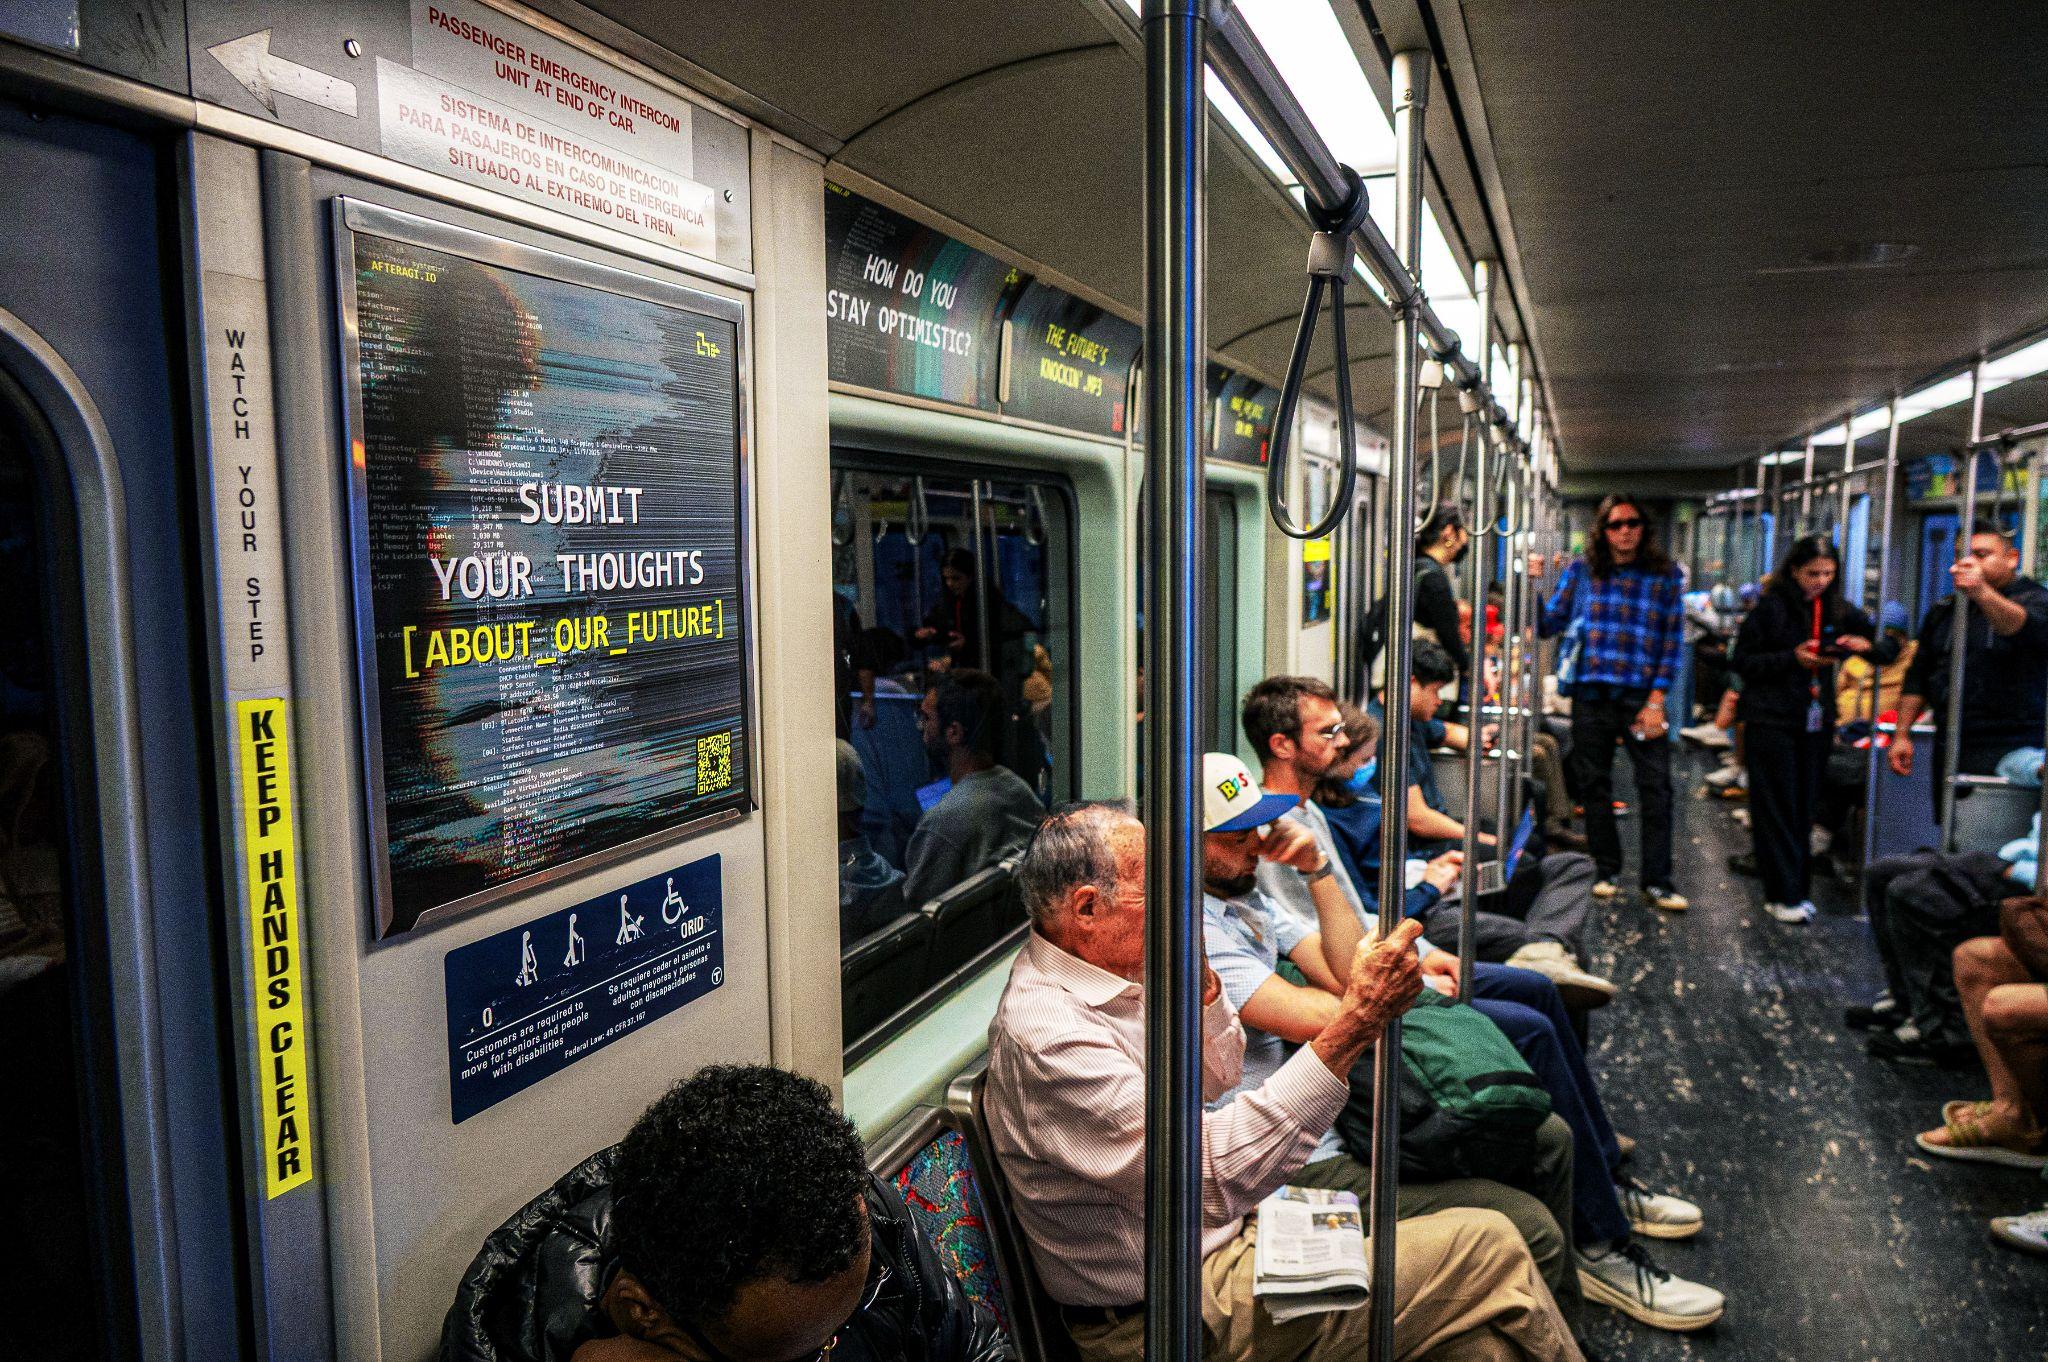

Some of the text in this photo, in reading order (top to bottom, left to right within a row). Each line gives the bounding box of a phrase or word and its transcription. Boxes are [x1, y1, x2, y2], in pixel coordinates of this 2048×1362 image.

[429, 6, 680, 133] PASSENGER EMERGENCY INTERCOM
[495, 60, 636, 135] UNIT AT END OF CAR.
[399, 104, 705, 228] PARA PASAJEROS EN CASO DE EMERGENCIA
[440, 94, 679, 198] SISTEMA DE INTERCOMUNICACION
[448, 146, 676, 237] SITUADO AL EXTREMO DEL TREN.
[371, 260, 437, 283] AFTERAGI.IO
[863, 253, 957, 310] HOW DO YOU
[827, 289, 871, 327] STAY
[878, 306, 972, 356] OPTIMISTIC?
[225, 328, 264, 663] WATCH YOUR STEP
[519, 484, 644, 525] SUBMIT
[431, 550, 705, 601] YOUR THOUGHTS
[403, 599, 724, 679] [ABOUT_OUR_FUTURE]
[512, 774, 538, 786] Security
[250, 710, 302, 1183] KEEP HANDS CLEAR
[608, 985, 618, 996] Se
[620, 970, 651, 990] requiere
[652, 960, 675, 975] ceder
[673, 955, 680, 965] el
[681, 947, 705, 961] asiento
[612, 954, 709, 1006] adultos mayores y personas
[630, 972, 696, 1010] con discapacidades
[461, 1011, 589, 1080] move for seniors and people
[467, 1001, 584, 1062] Customers are required to
[492, 1037, 564, 1079] with disabilities
[564, 1011, 646, 1059] Federal Law: 49 CFR 37.167
